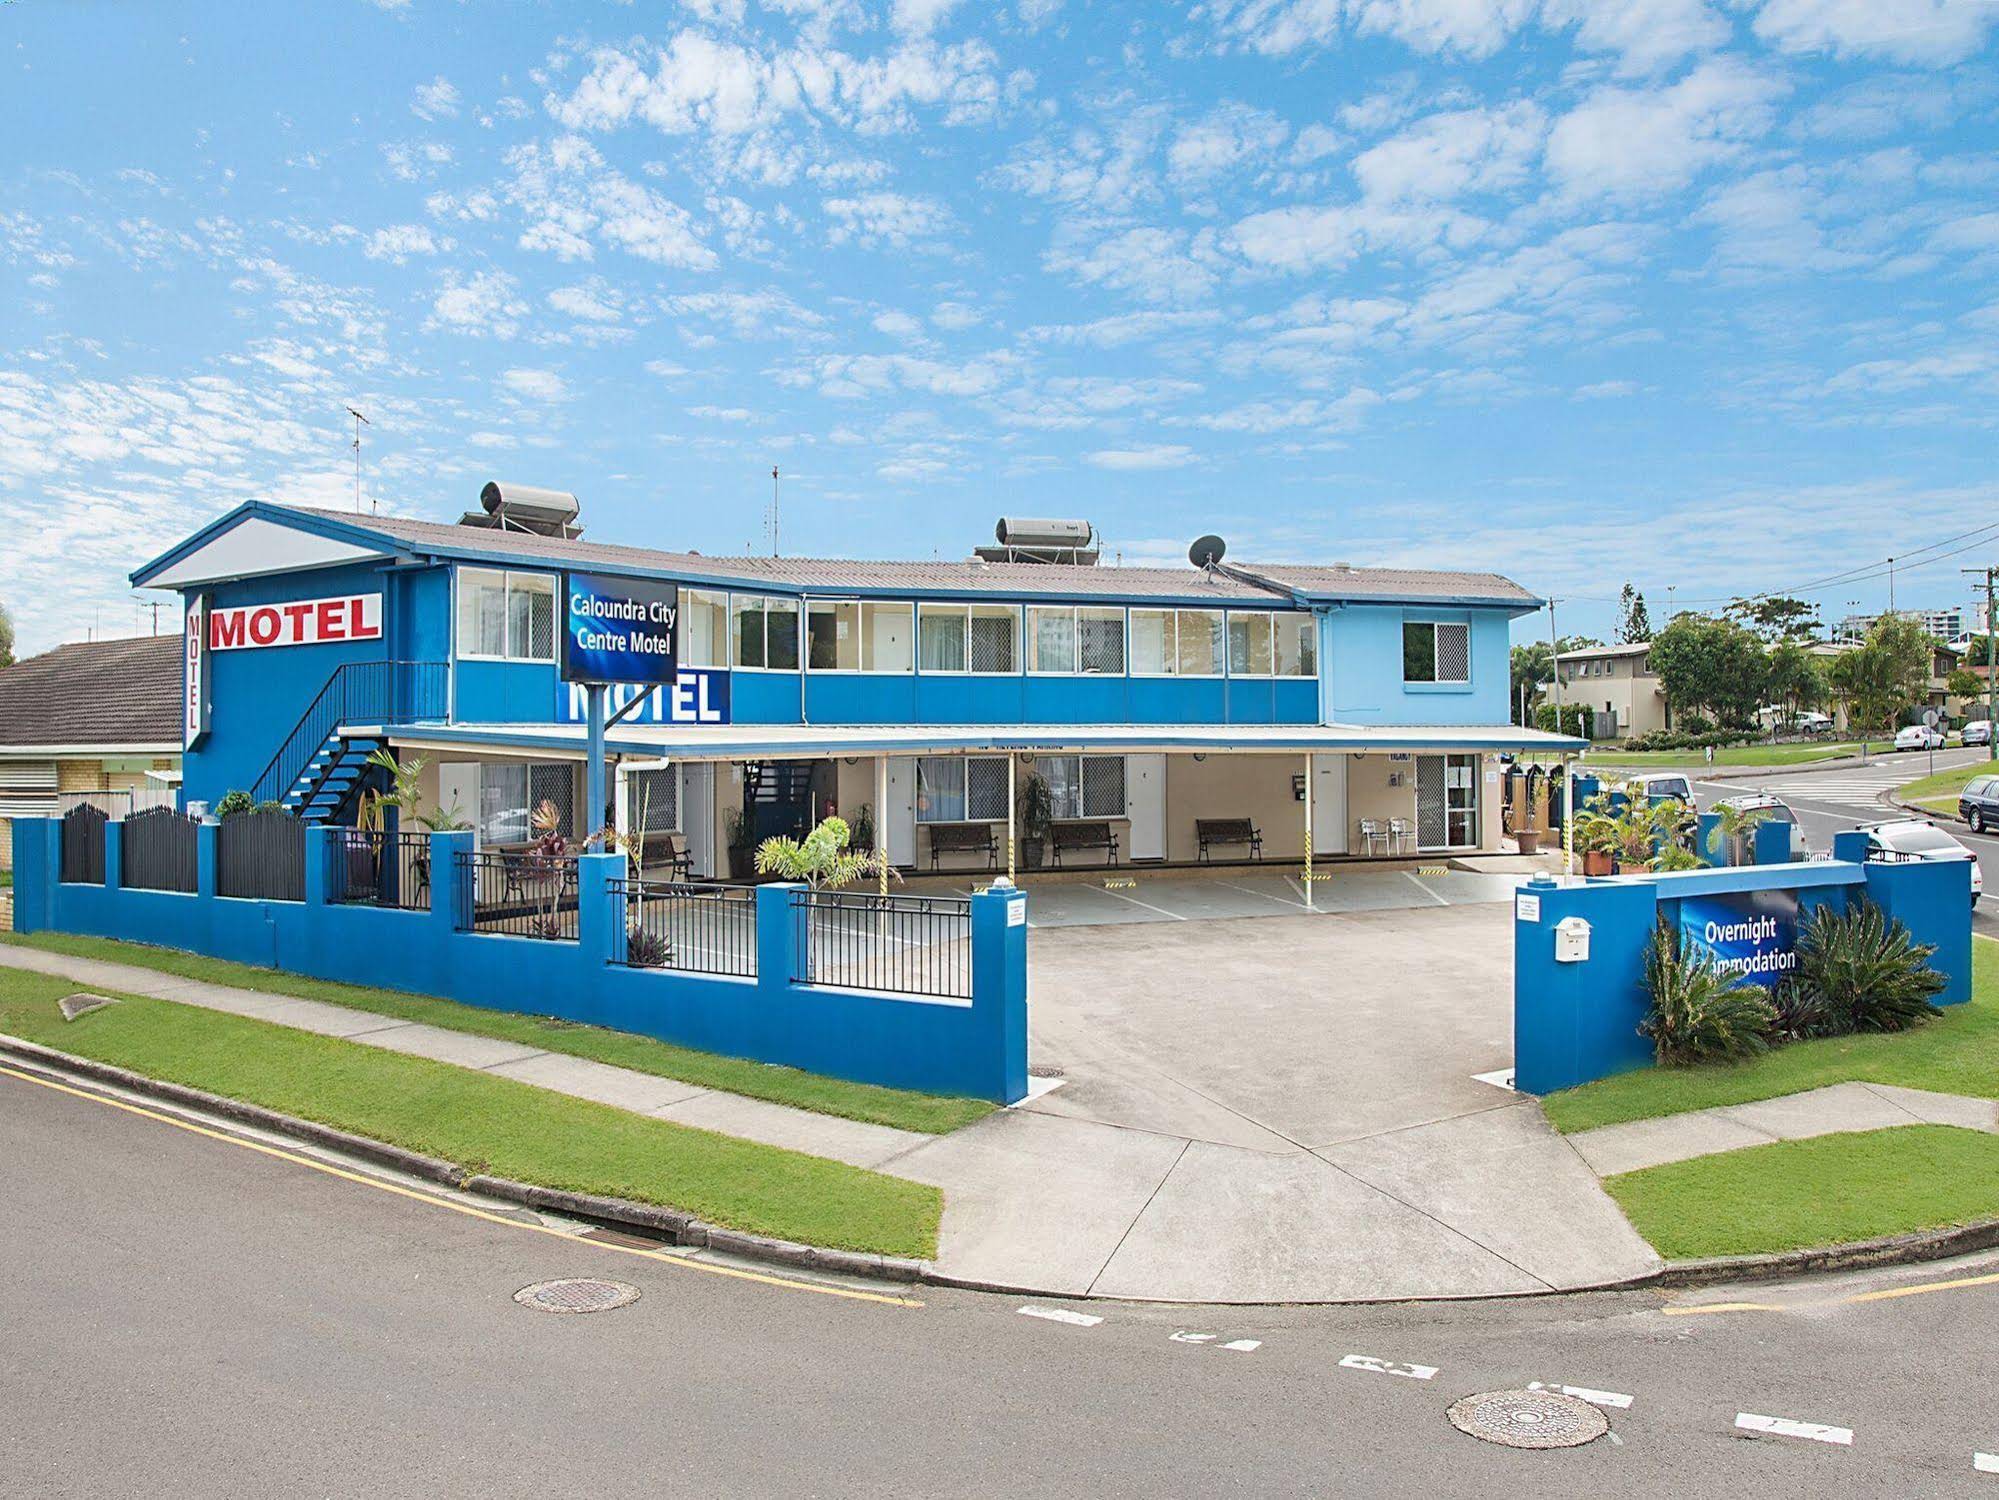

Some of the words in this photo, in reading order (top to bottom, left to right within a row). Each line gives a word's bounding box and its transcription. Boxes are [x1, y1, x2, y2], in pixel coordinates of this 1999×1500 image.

[211, 599, 379, 648] MOTEL
[571, 593, 647, 622] Caloundra
[650, 601, 677, 629] City
[577, 627, 627, 652] Centre
[630, 631, 671, 655] Motel
[188, 615, 200, 729] MOTEL
[1705, 915, 1777, 945] Overnight
